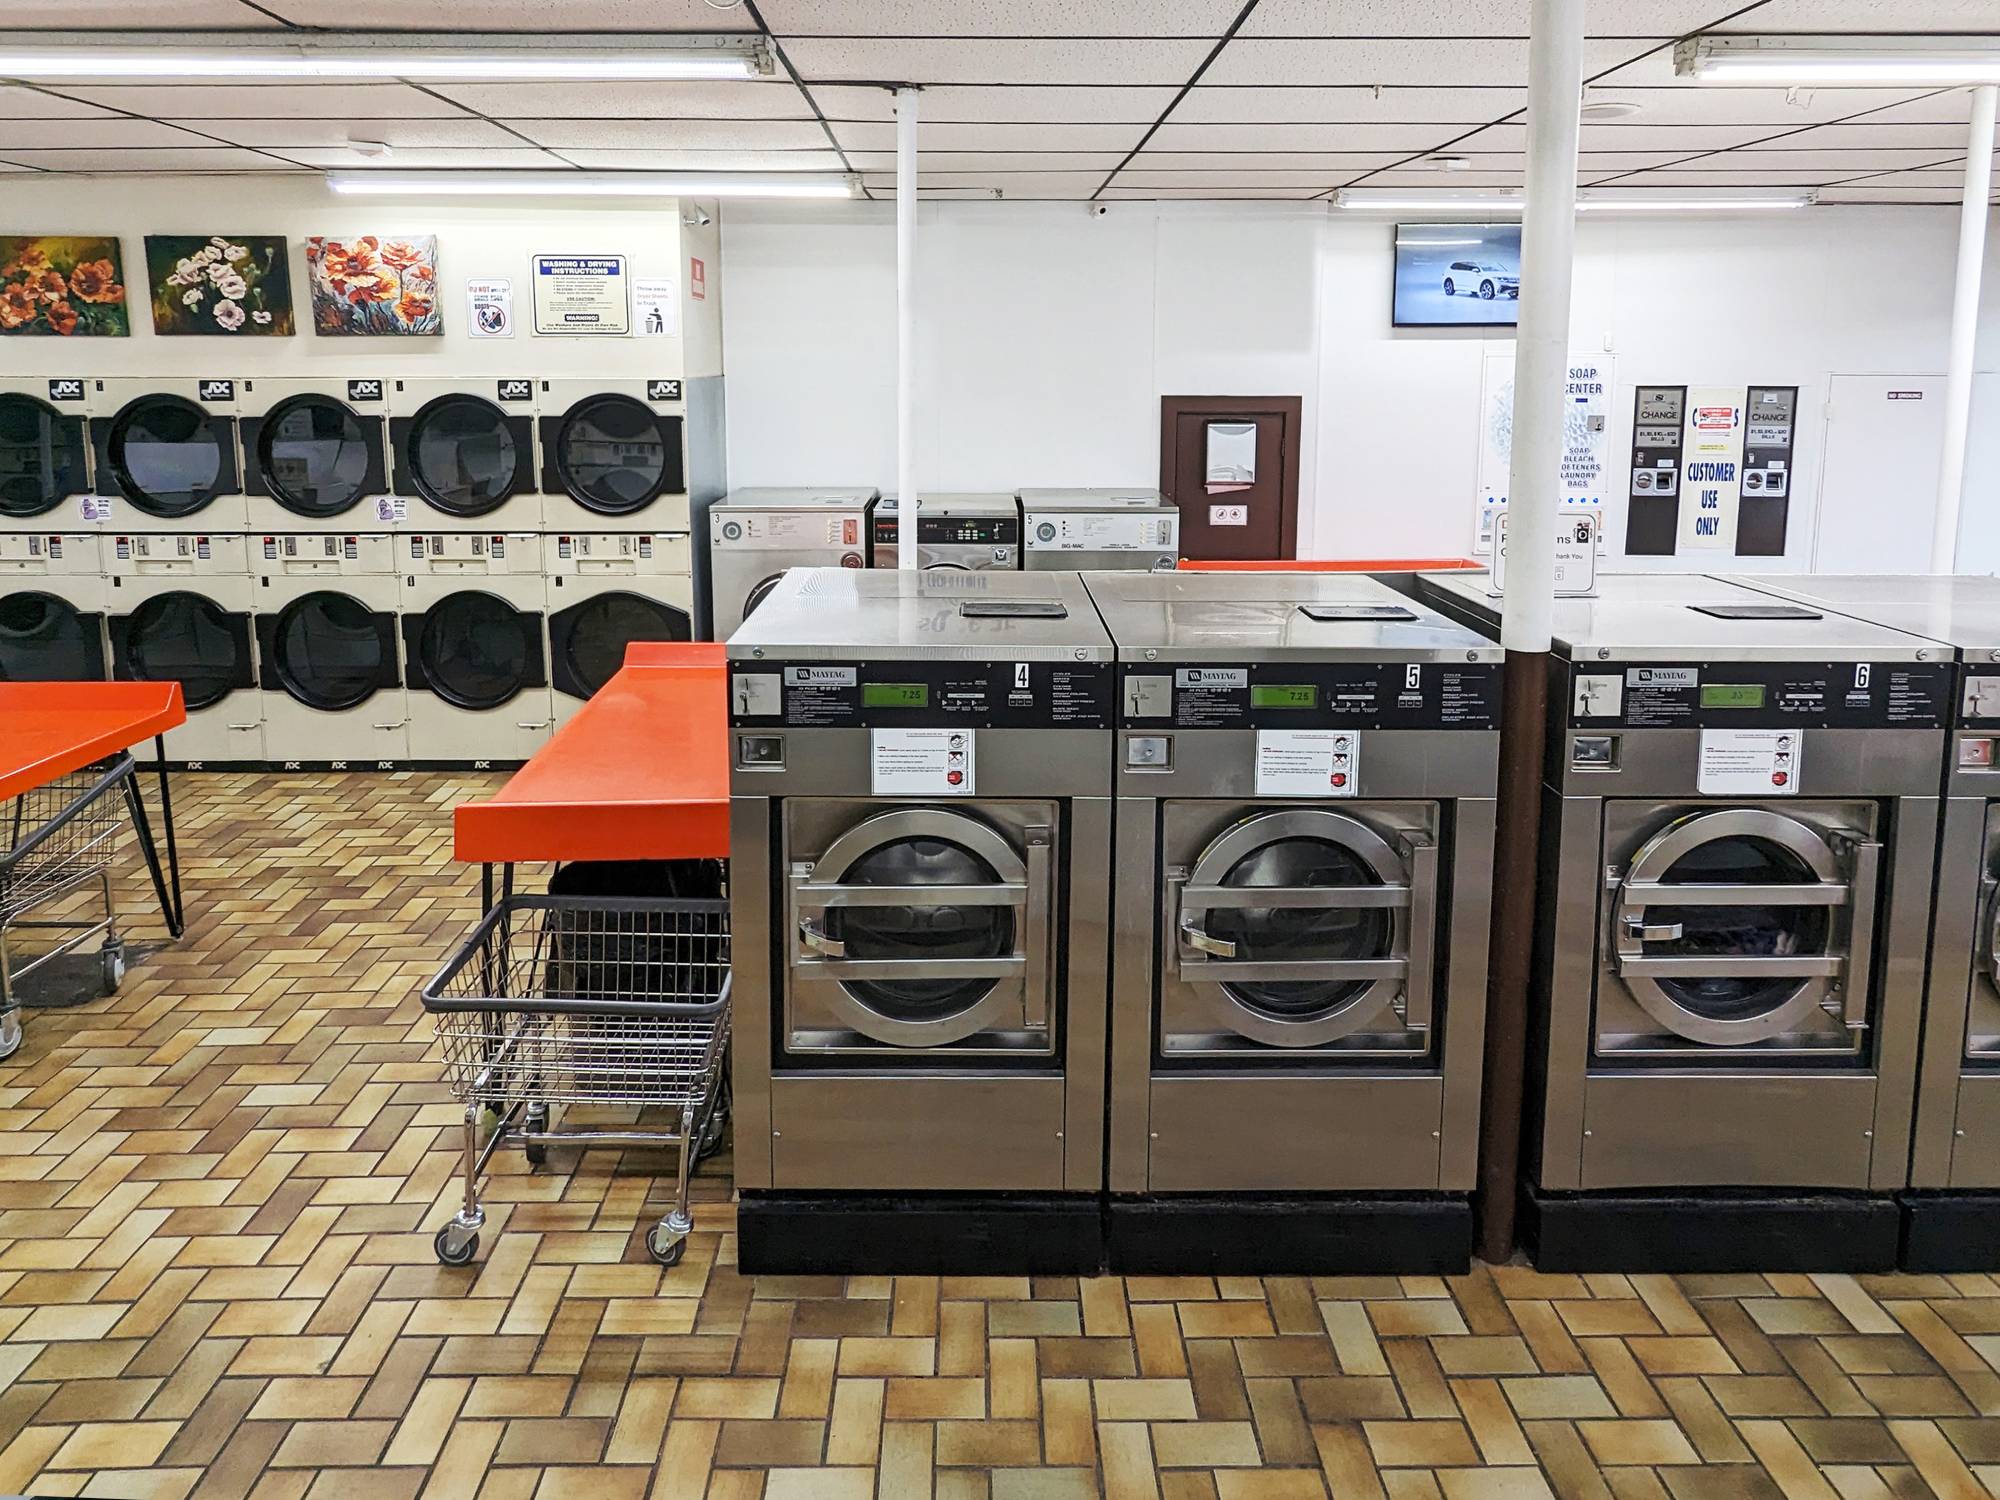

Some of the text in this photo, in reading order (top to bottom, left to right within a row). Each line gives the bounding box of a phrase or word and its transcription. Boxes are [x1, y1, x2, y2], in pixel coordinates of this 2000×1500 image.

[1569, 368, 1597, 379] SOAP
[57, 381, 80, 393] ADC
[207, 382, 230, 393] ADC
[356, 381, 379, 394] ADC
[505, 382, 528, 393] ADC
[655, 381, 678, 394] ADC
[1641, 411, 1677, 419] CHANGE
[1752, 413, 1789, 421] CHANGE
[1561, 463, 1601, 471] OFTENERS
[1688, 462, 1735, 481] CUSTOMER
[1701, 490, 1718, 509] USE
[714, 514, 720, 524] 3
[1027, 515, 1033, 525] 5
[1696, 517, 1720, 536] ONLY
[1017, 665, 1028, 687] 4
[1202, 672, 1236, 680] MAYTAG
[1408, 666, 1419, 688] 5
[1653, 672, 1687, 680] MAYTAG
[1857, 666, 1868, 687] 6
